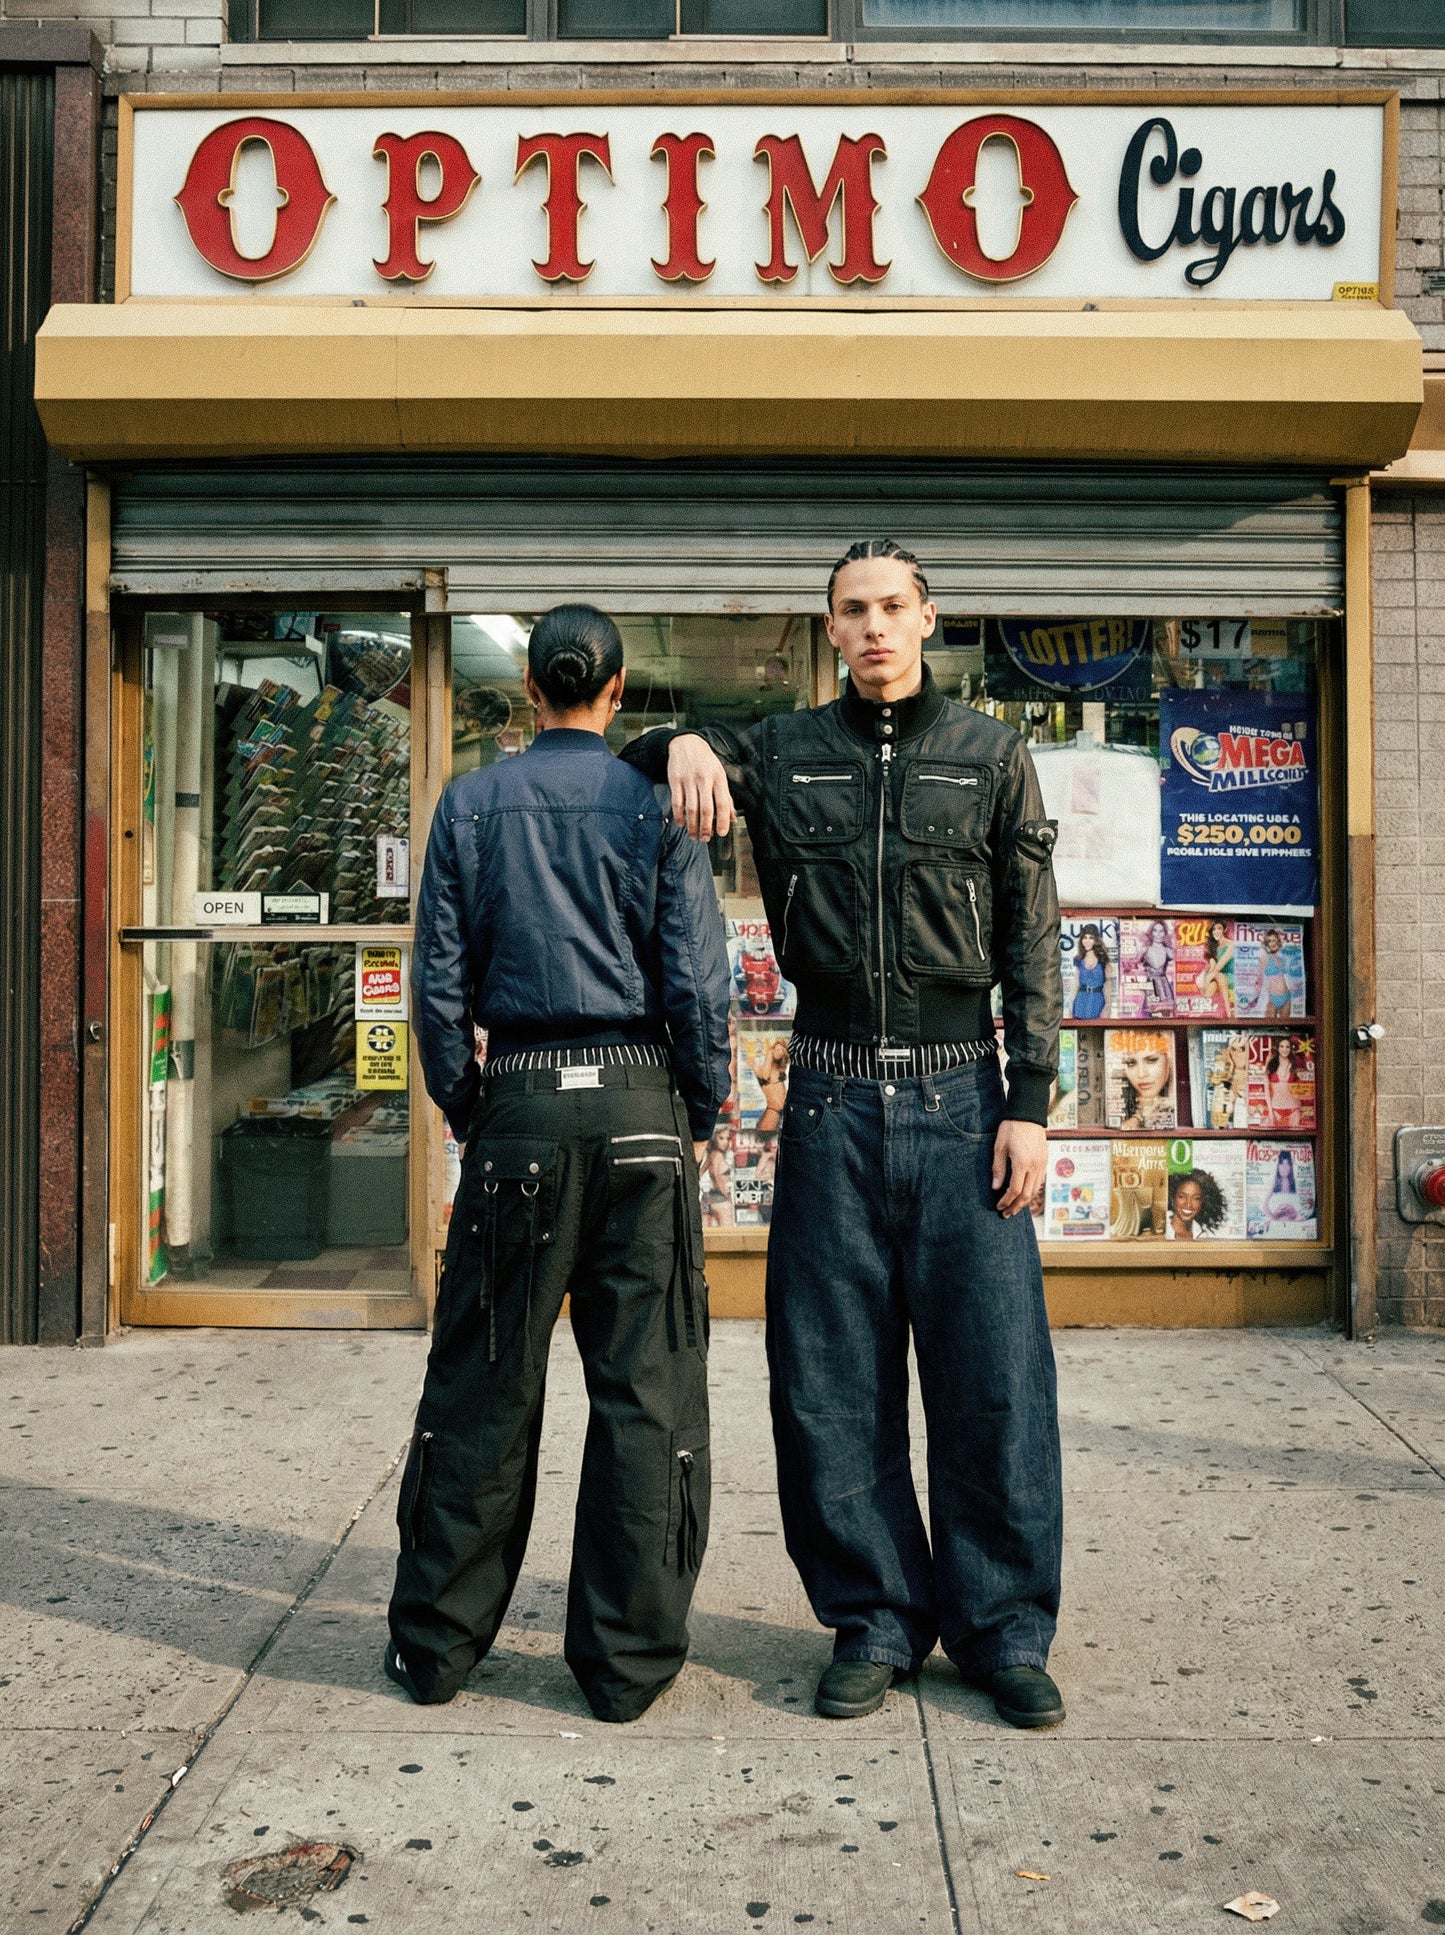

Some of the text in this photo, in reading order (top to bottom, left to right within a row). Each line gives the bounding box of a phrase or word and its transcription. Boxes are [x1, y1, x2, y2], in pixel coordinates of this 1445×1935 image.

[173, 113, 1346, 287] OPTIMO Cigars
[1217, 732, 1306, 769] MEGA
[1292, 814, 1300, 823] A
[1177, 823, 1302, 846] $250,000
[203, 902, 244, 914] OPEN
